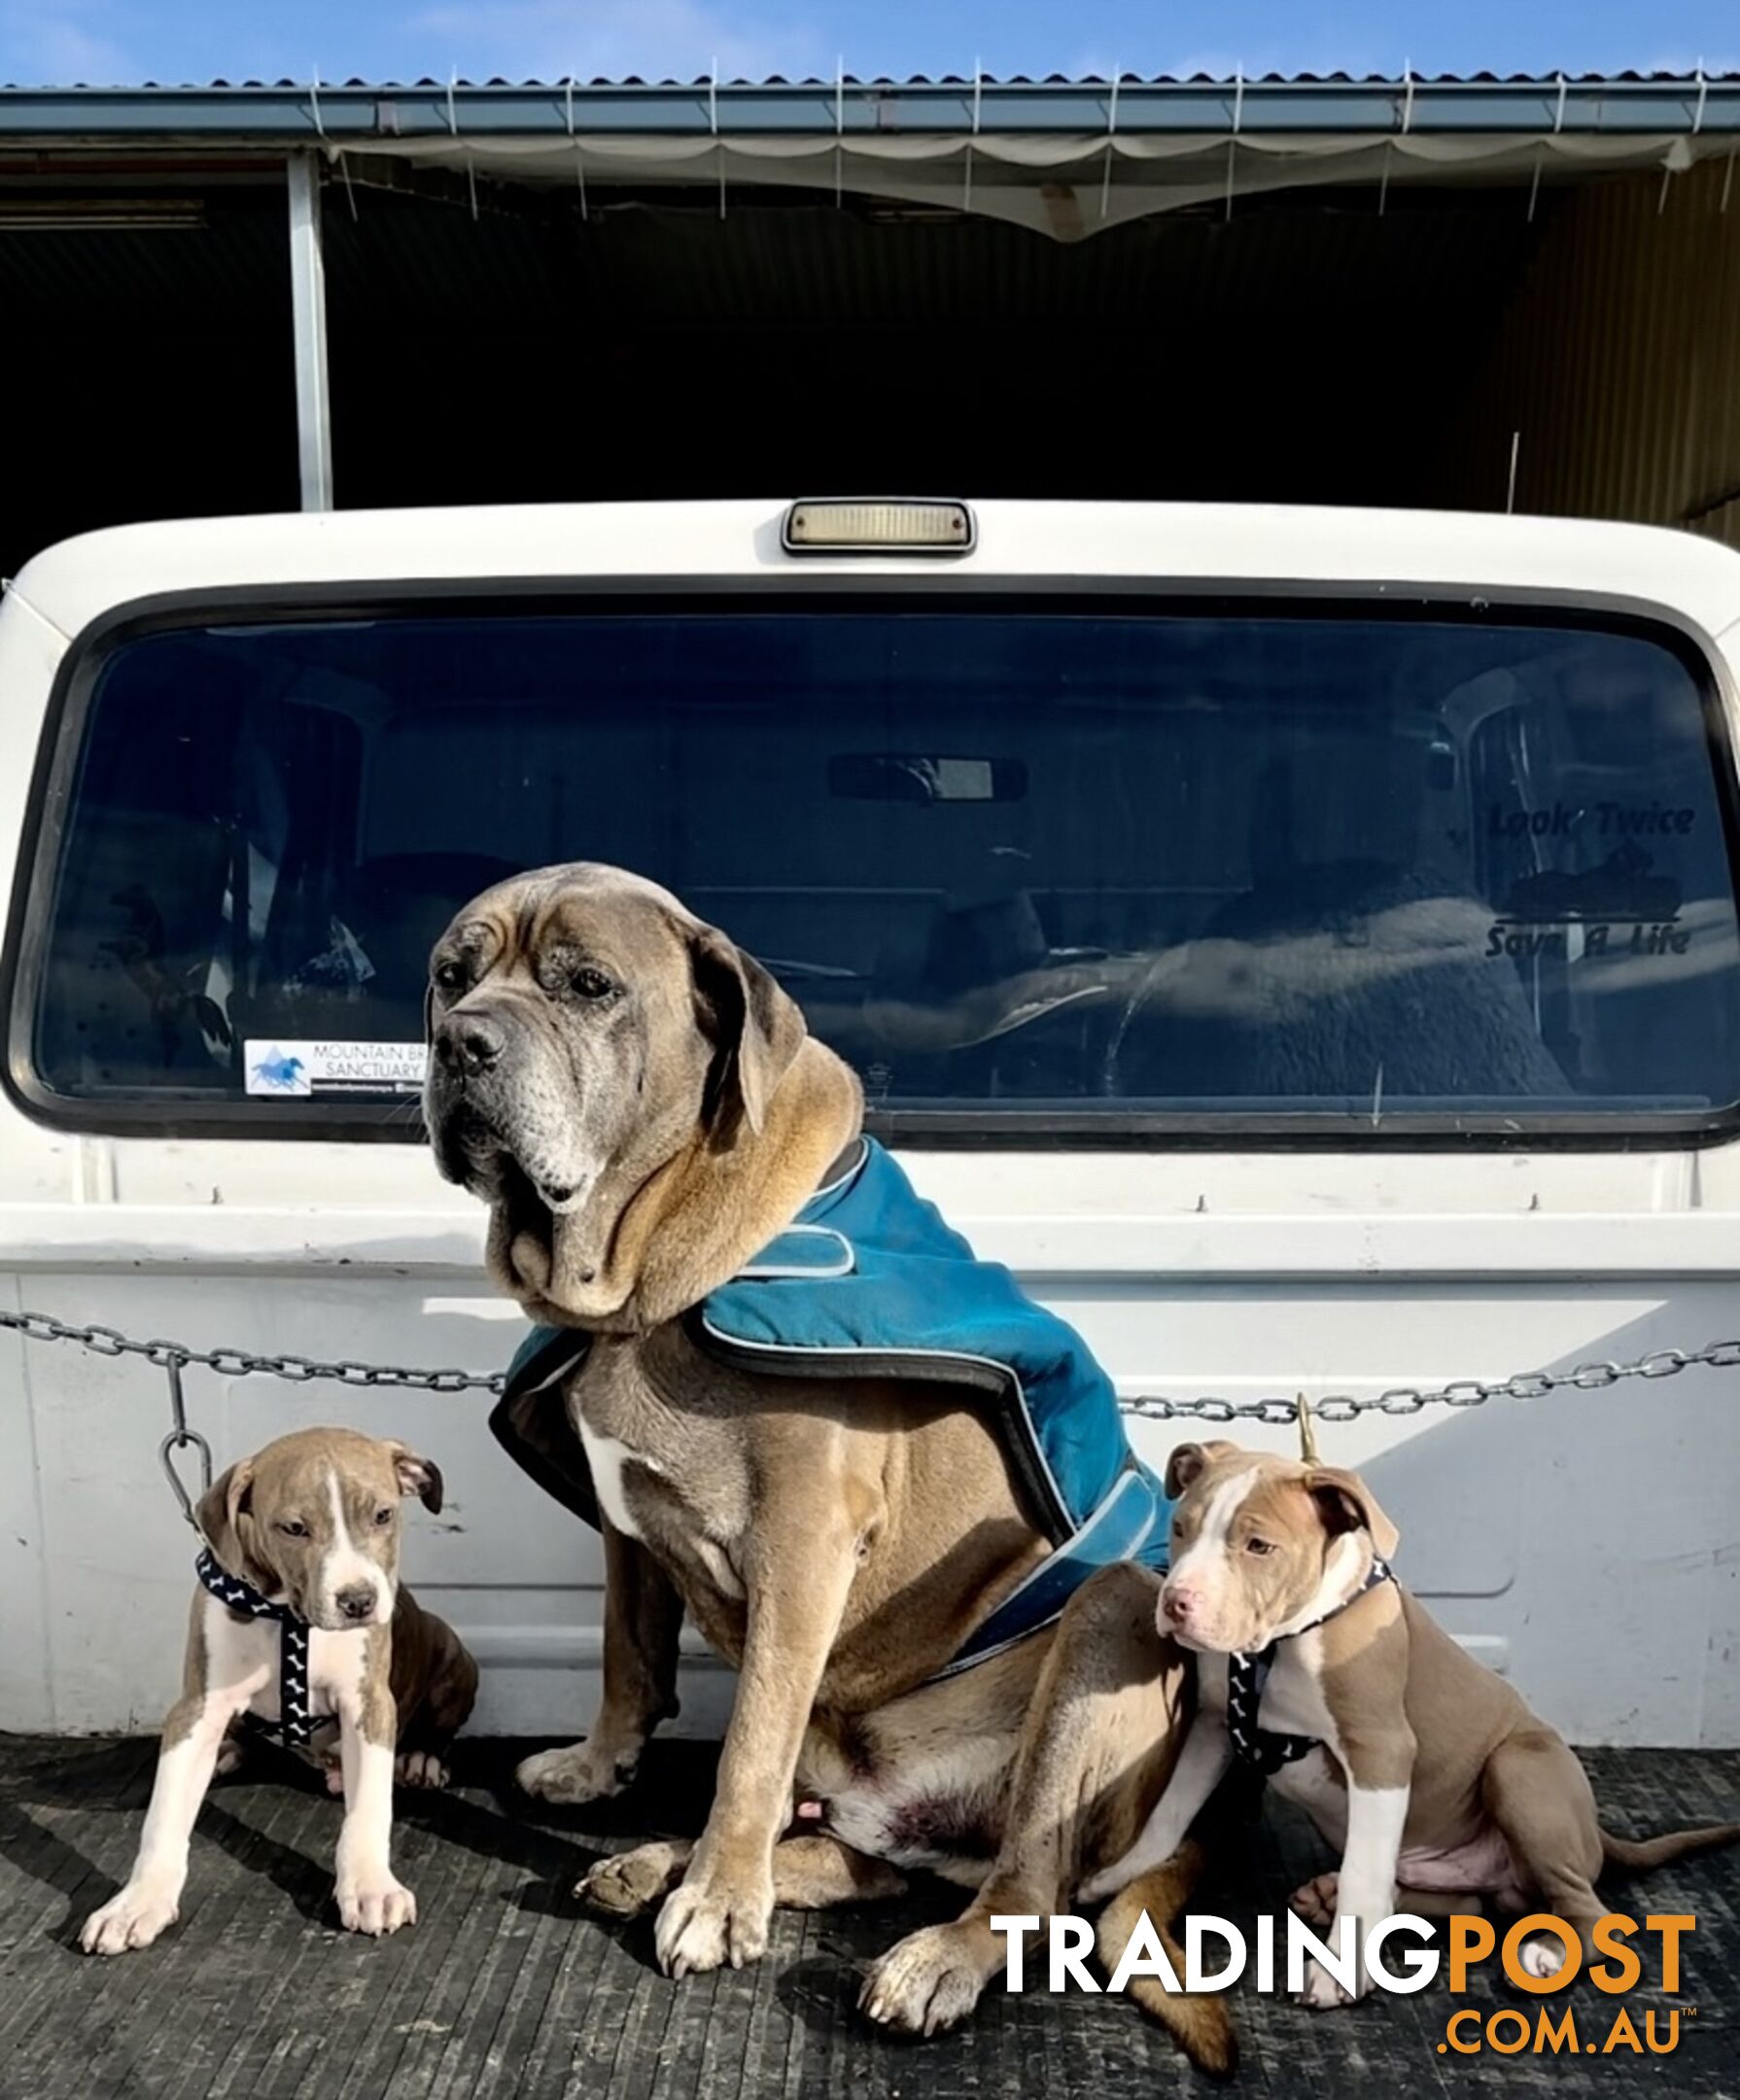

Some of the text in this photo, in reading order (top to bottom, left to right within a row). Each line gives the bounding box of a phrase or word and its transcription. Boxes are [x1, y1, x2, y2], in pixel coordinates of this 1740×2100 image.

[1487, 801, 1695, 835] Look Twice
[1584, 926, 1610, 958] A
[1630, 926, 1691, 956] Life
[313, 1044, 402, 1060] MOUNTAIN
[326, 1061, 421, 1077] SANCTUARY
